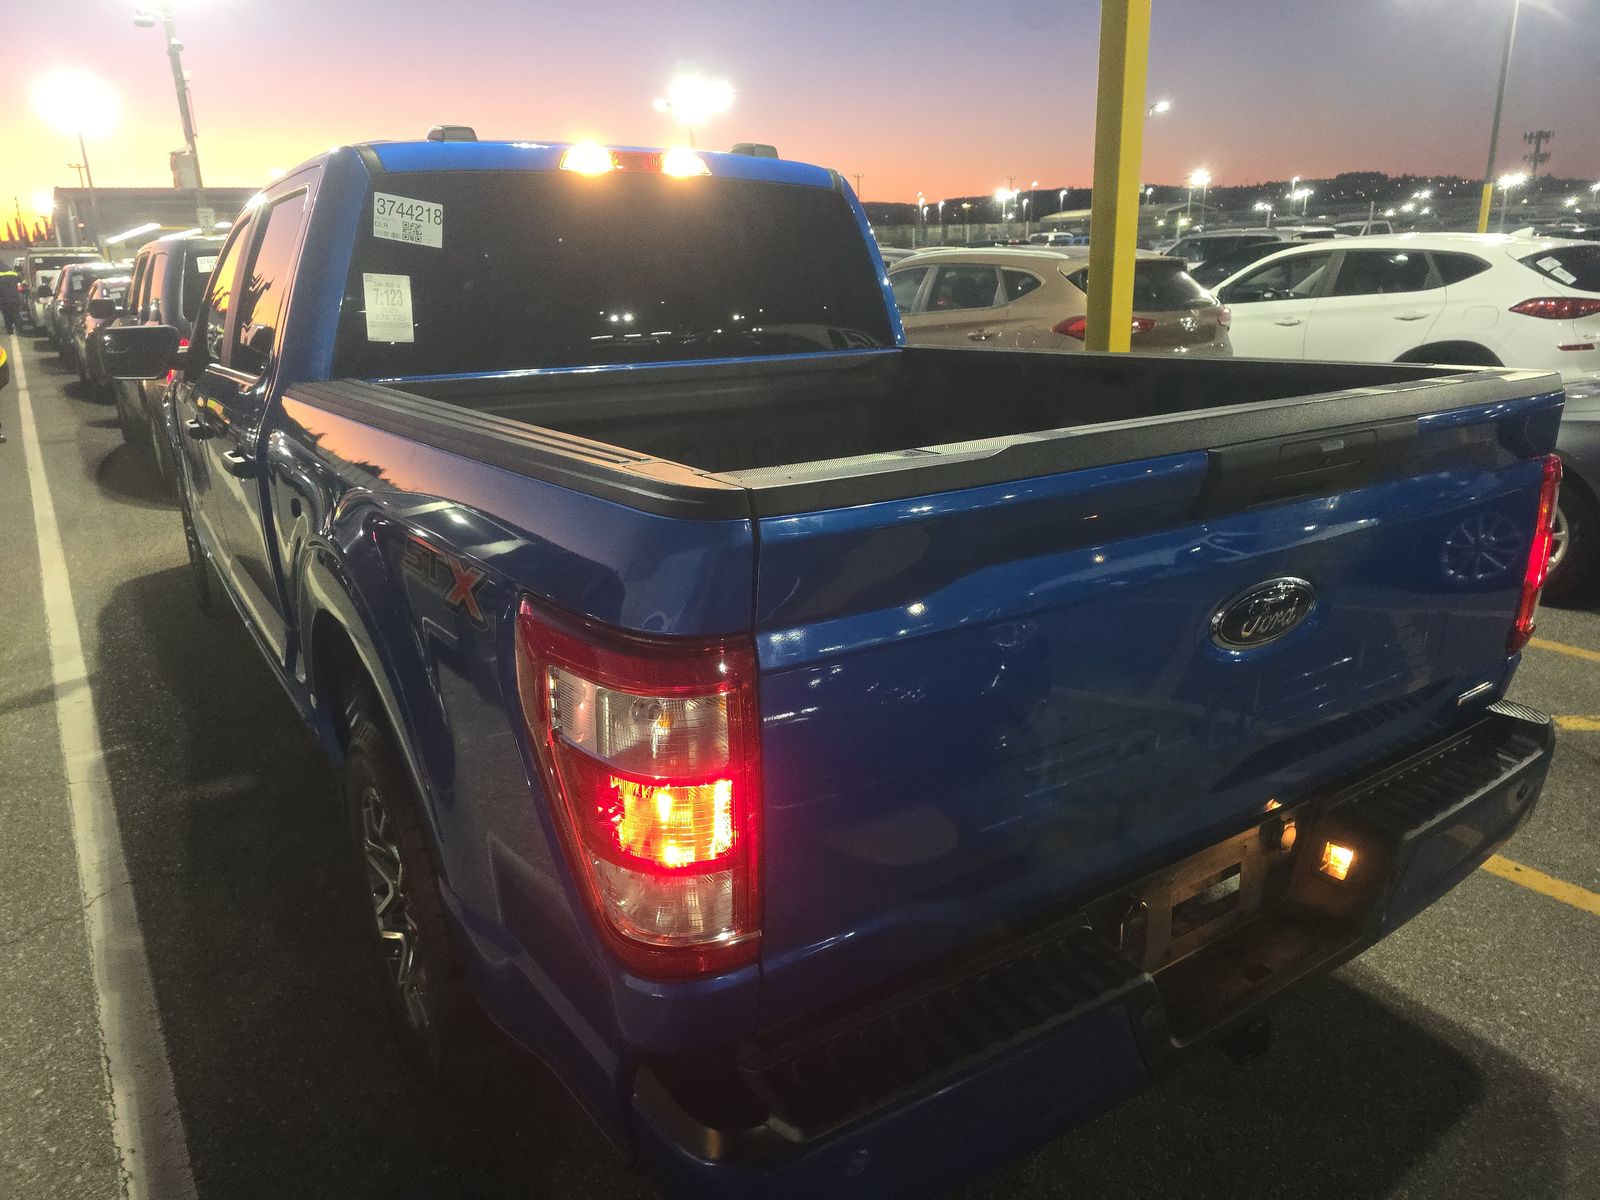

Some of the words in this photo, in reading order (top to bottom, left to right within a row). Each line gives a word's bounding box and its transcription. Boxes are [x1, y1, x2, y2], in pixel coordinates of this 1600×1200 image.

[376, 197, 442, 226] 3744218
[400, 535, 487, 625] STX
[1241, 592, 1299, 638] Ford
